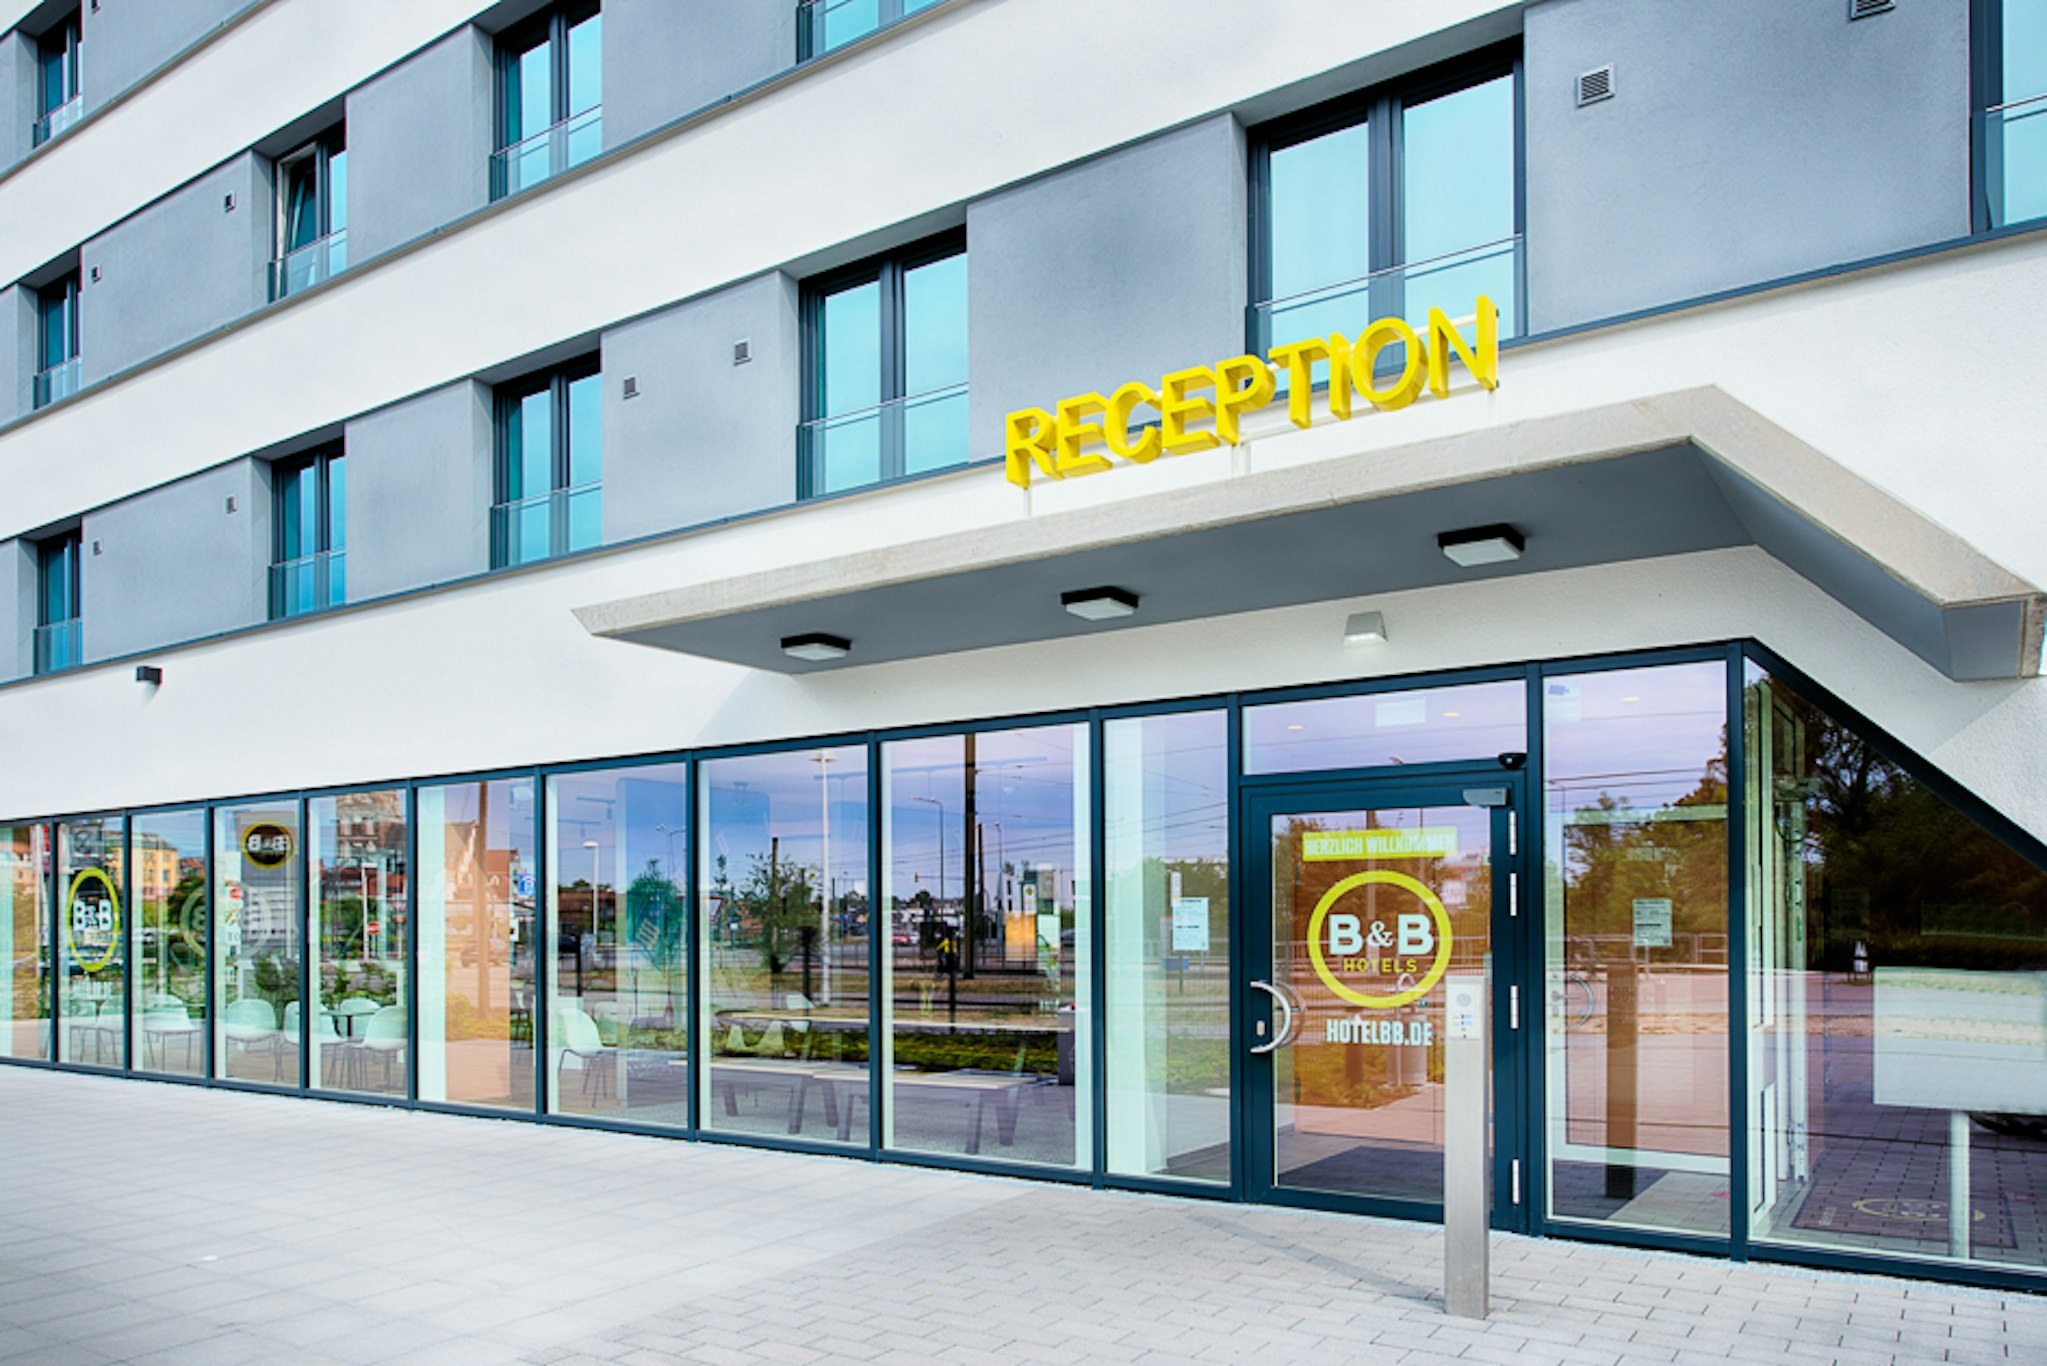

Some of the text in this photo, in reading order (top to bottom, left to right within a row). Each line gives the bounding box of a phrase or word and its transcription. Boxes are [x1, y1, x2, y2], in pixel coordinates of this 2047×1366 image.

[1005, 295, 1498, 489] RECEPTION
[1304, 838, 1363, 856] HERZLICH
[73, 899, 112, 931] B&B
[1328, 914, 1434, 955] B&B
[1343, 959, 1418, 973] HOTELS
[1326, 1018, 1433, 1046] HOTELBB.DE
